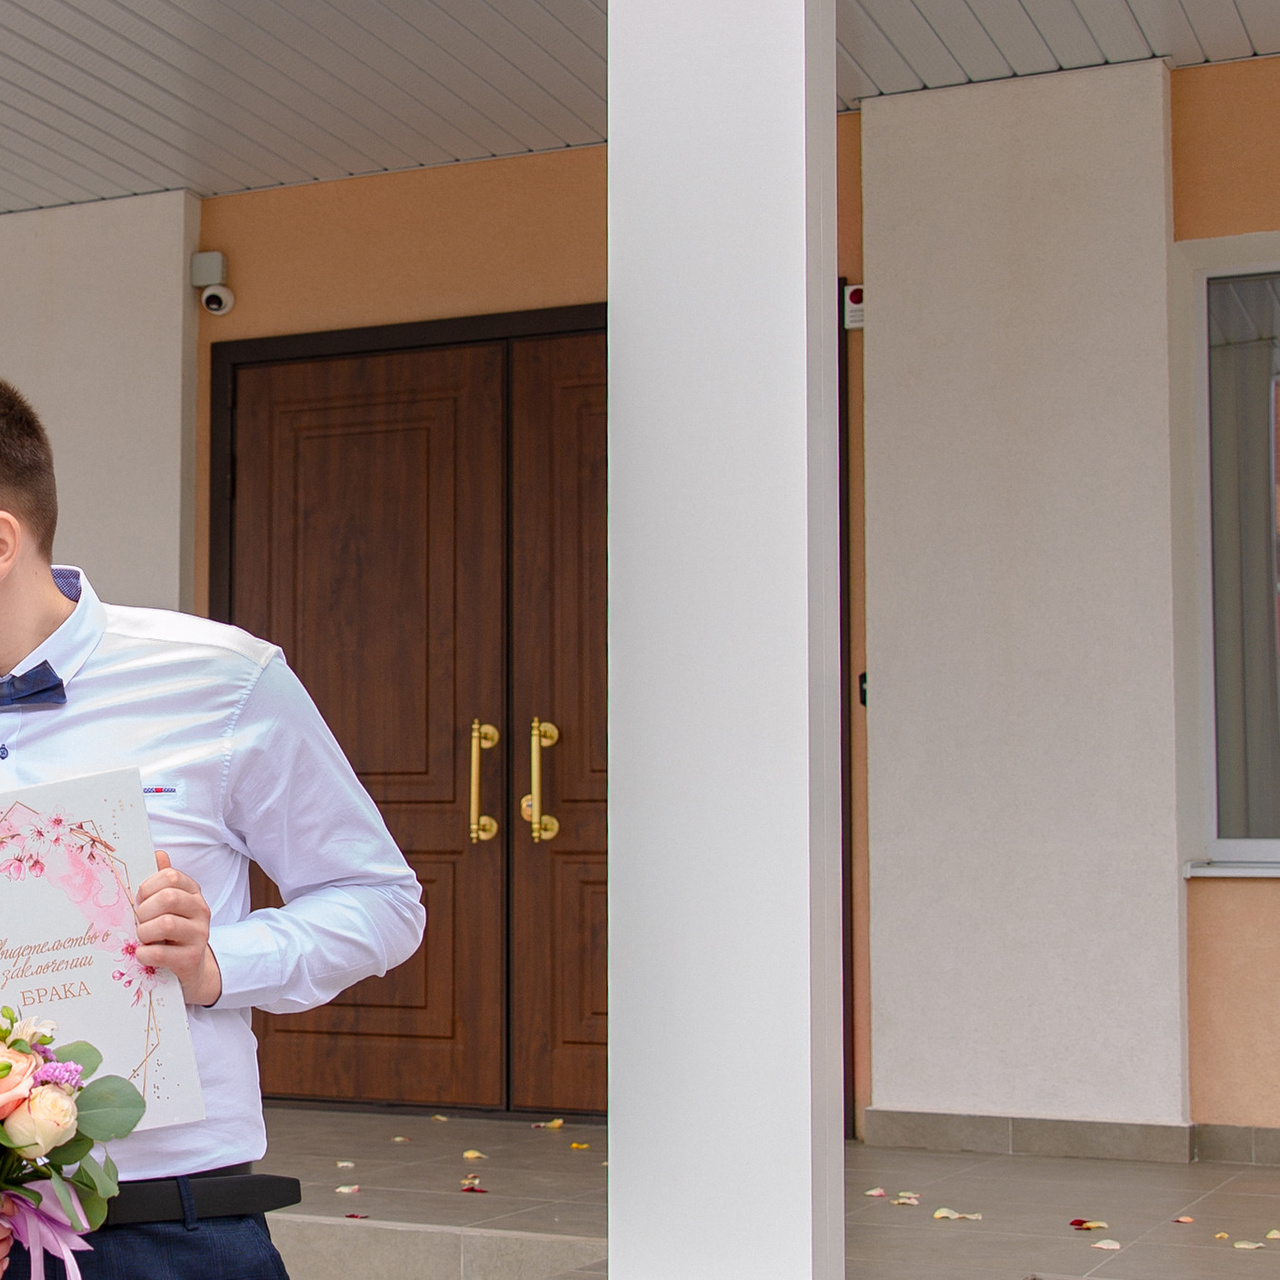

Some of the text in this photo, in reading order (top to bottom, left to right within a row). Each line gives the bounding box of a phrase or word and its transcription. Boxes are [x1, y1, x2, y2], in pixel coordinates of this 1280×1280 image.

[101, 929, 112, 943] о
[0, 955, 94, 990] заключении
[20, 980, 92, 1007] БРАКА
